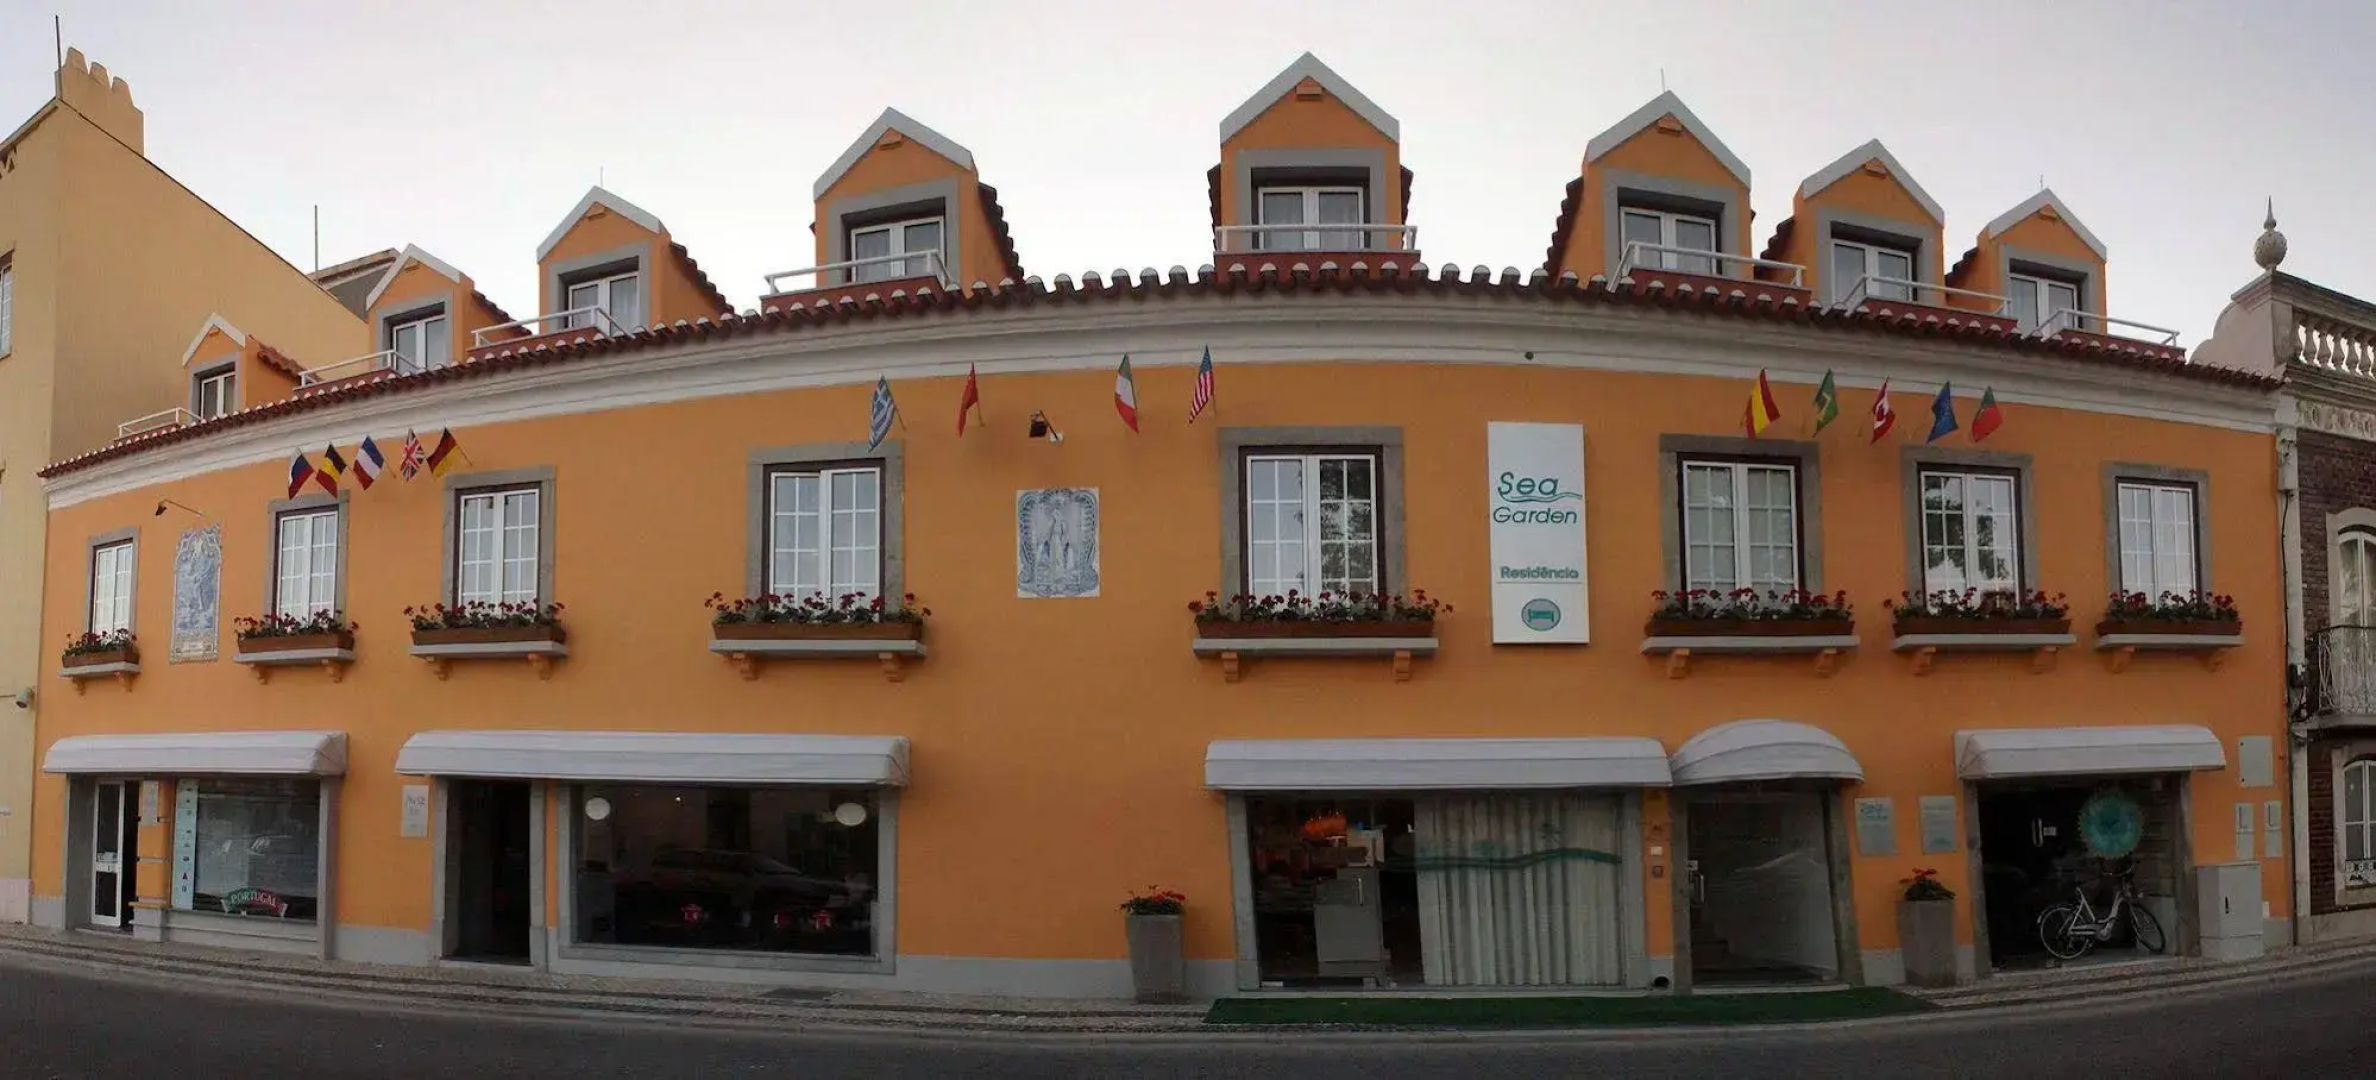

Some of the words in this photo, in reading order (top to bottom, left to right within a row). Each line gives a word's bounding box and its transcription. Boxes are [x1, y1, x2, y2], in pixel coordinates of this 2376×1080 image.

[1497, 471, 1560, 497] Sea
[1492, 506, 1578, 524] Garden
[1500, 565, 1579, 580] Residência
[230, 890, 277, 906] PORTUGAL
